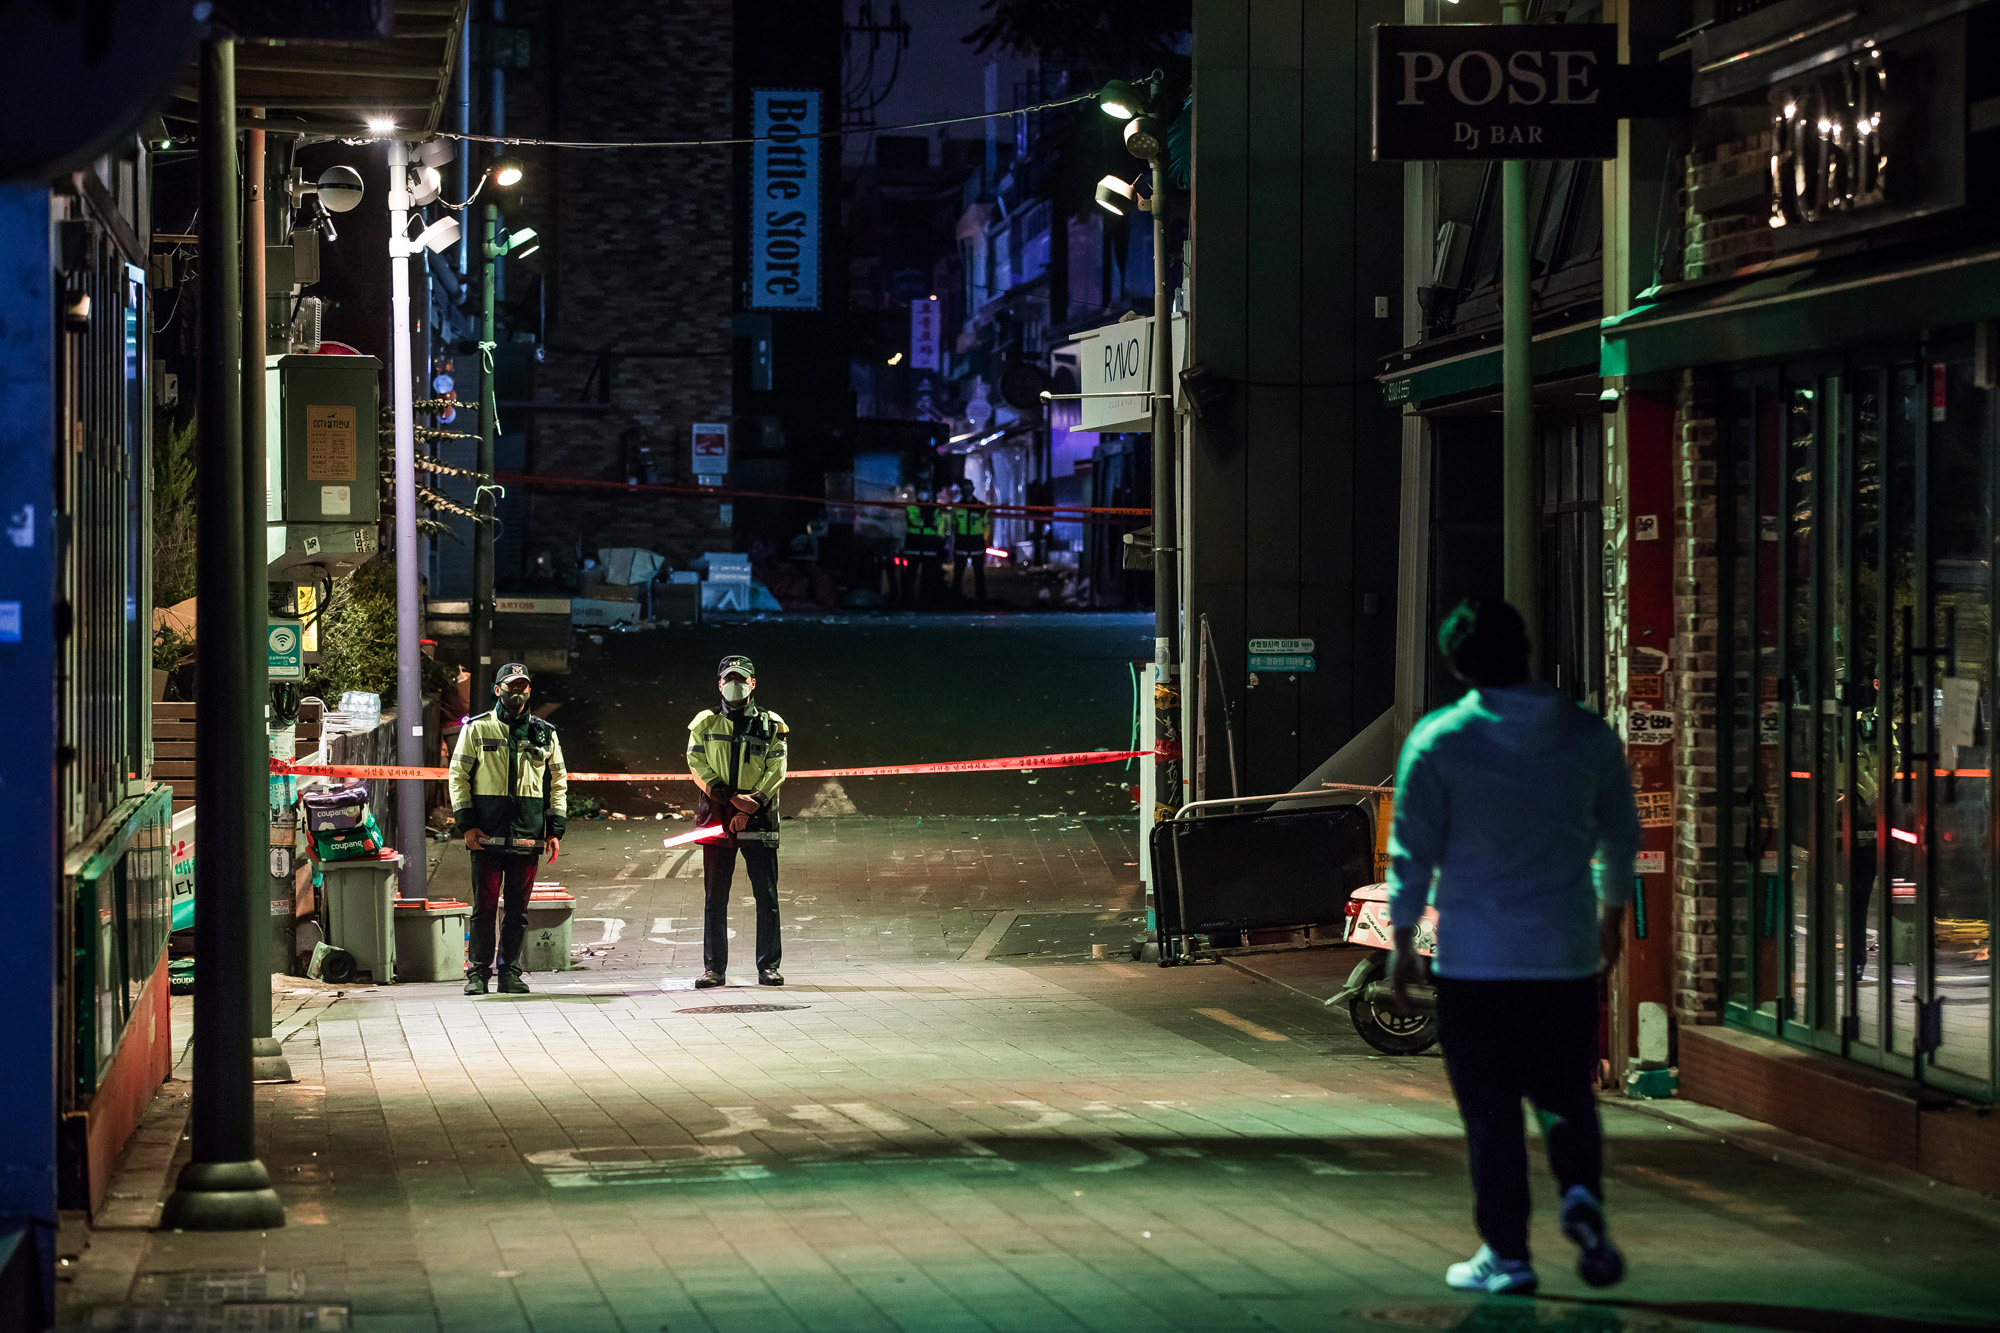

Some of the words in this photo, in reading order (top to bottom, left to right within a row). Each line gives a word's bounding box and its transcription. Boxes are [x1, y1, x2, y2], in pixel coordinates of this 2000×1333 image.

[1395, 50, 1601, 106] POSE
[766, 98, 806, 200] Bottle
[1490, 125, 1543, 144] BAR
[765, 211, 806, 296] Store
[1104, 338, 1139, 383] RAVO
[330, 840, 364, 850] coupang
[172, 976, 196, 986] coupa
